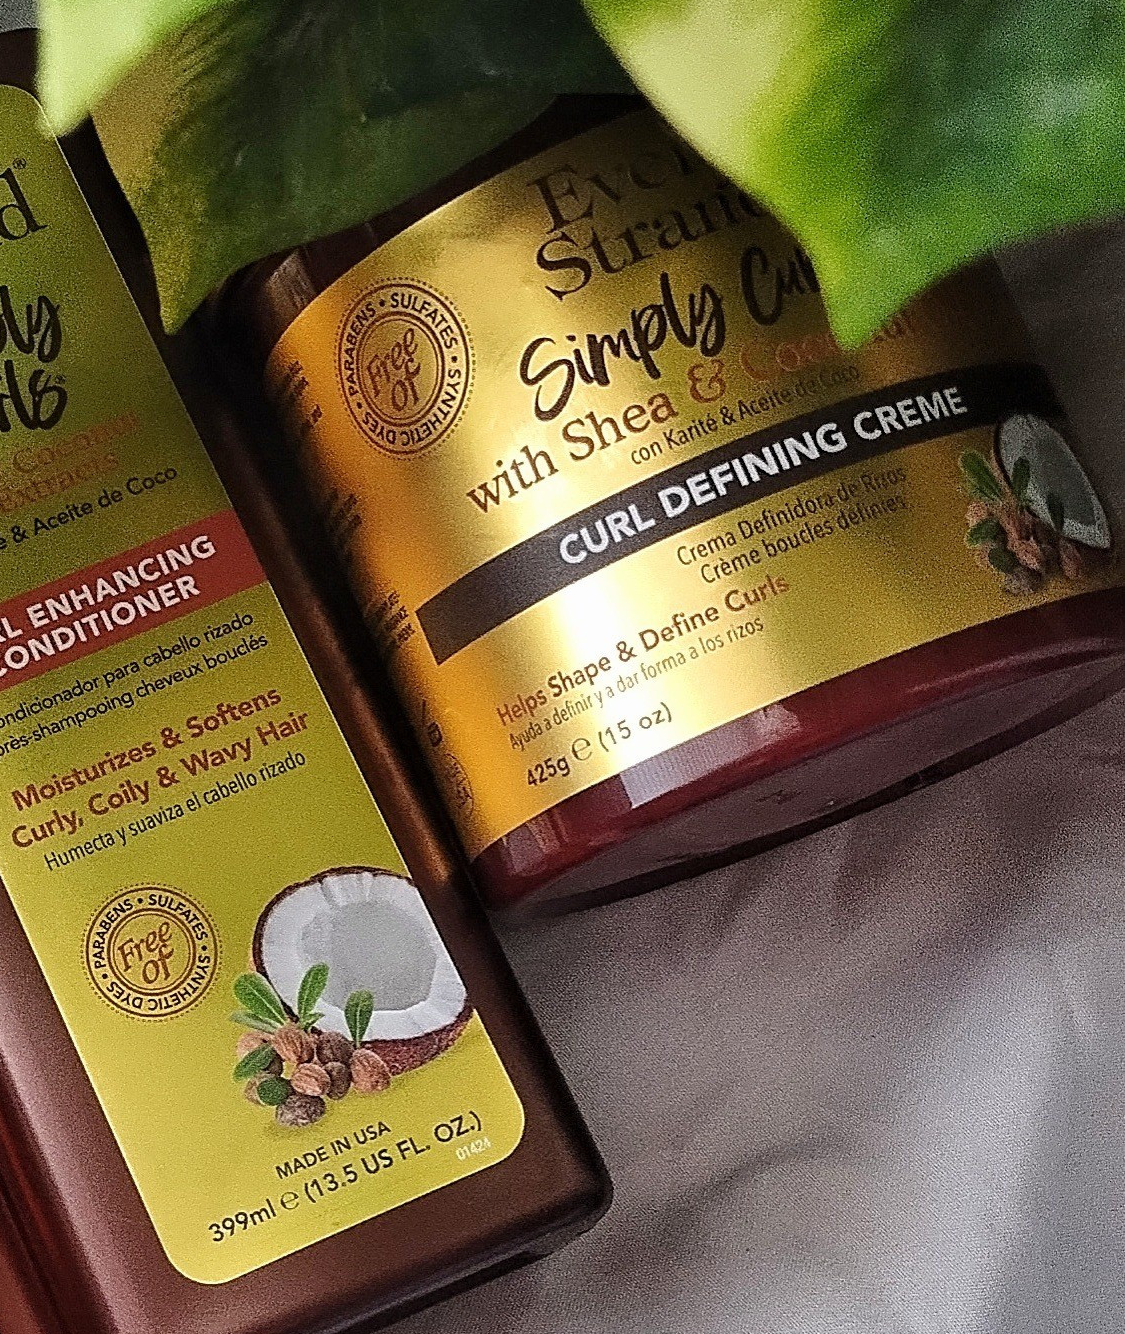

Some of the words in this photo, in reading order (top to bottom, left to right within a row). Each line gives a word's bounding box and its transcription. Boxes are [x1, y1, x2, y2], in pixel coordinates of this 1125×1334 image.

[344, 302, 376, 396] PARABENS
[390, 292, 458, 349] SULFATES
[520, 271, 725, 421] Simply
[740, 244, 820, 326] Cur
[367, 328, 418, 398] Free
[362, 411, 397, 445] DYES
[400, 369, 461, 446] SYNTHETIC
[467, 445, 560, 514] with
[562, 391, 679, 462] Shea
[687, 359, 726, 404] &
[631, 440, 663, 465] con
[664, 411, 719, 451] Karité
[720, 406, 737, 428] &
[738, 385, 792, 420] Aceite
[10, 525, 29, 545] &
[33, 502, 94, 536] Aceite
[97, 489, 124, 510] de
[126, 467, 178, 496] Coco
[560, 505, 656, 565] CURL
[658, 422, 848, 519] DEFINING
[853, 386, 968, 441] CREME
[677, 530, 738, 566] Crema
[737, 493, 835, 540] Definidora
[701, 545, 761, 584] Crème
[762, 518, 834, 557] boucles
[26, 535, 216, 629] ENHANCING
[103, 661, 140, 689] para
[143, 634, 201, 668] cabello
[203, 612, 254, 643] rizado
[136, 663, 204, 699] cheveux
[206, 632, 268, 669] bouclés
[496, 689, 548, 726] Helps
[547, 655, 612, 698] Shape
[616, 640, 637, 662] &
[638, 606, 719, 652] Define
[724, 574, 790, 612] Curls
[509, 719, 543, 752] Ayuda
[543, 717, 552, 731] a
[553, 695, 594, 725] definir
[594, 689, 604, 708] y
[606, 686, 615, 699] a
[616, 673, 639, 694] dar
[640, 652, 687, 681] forma
[689, 645, 699, 659] a
[699, 634, 724, 655] los
[727, 616, 765, 643] rizos
[11, 739, 157, 812] Moisturizes
[160, 726, 184, 749] &
[185, 688, 282, 739] Softens
[12, 809, 85, 849] Curly,
[87, 778, 150, 817] Coily
[156, 766, 180, 789] &
[179, 736, 252, 777] Wavy
[256, 710, 309, 747] Hair
[527, 755, 571, 787] 425g
[598, 719, 632, 752] (15
[638, 702, 672, 730] oz)
[44, 831, 116, 872] Humecta
[115, 827, 127, 848] y
[128, 804, 185, 837] suaviza
[186, 790, 201, 812] el
[202, 771, 258, 806] cabello
[259, 750, 307, 782] rizado
[92, 898, 134, 970] PARABENS
[117, 921, 173, 972] Free
[148, 893, 208, 941] SULFATES
[106, 981, 144, 1010] DYES
[147, 953, 211, 1012] SYNTHETIC
[208, 1198, 277, 1243] 399ml
[304, 1162, 358, 1204] (13.5
[361, 1148, 394, 1174] US
[396, 1136, 431, 1161] FL.
[433, 1110, 482, 1145] OZ.)
[275, 1146, 328, 1180] MADE
[330, 1135, 352, 1156] IN
[355, 1121, 392, 1146] USA
